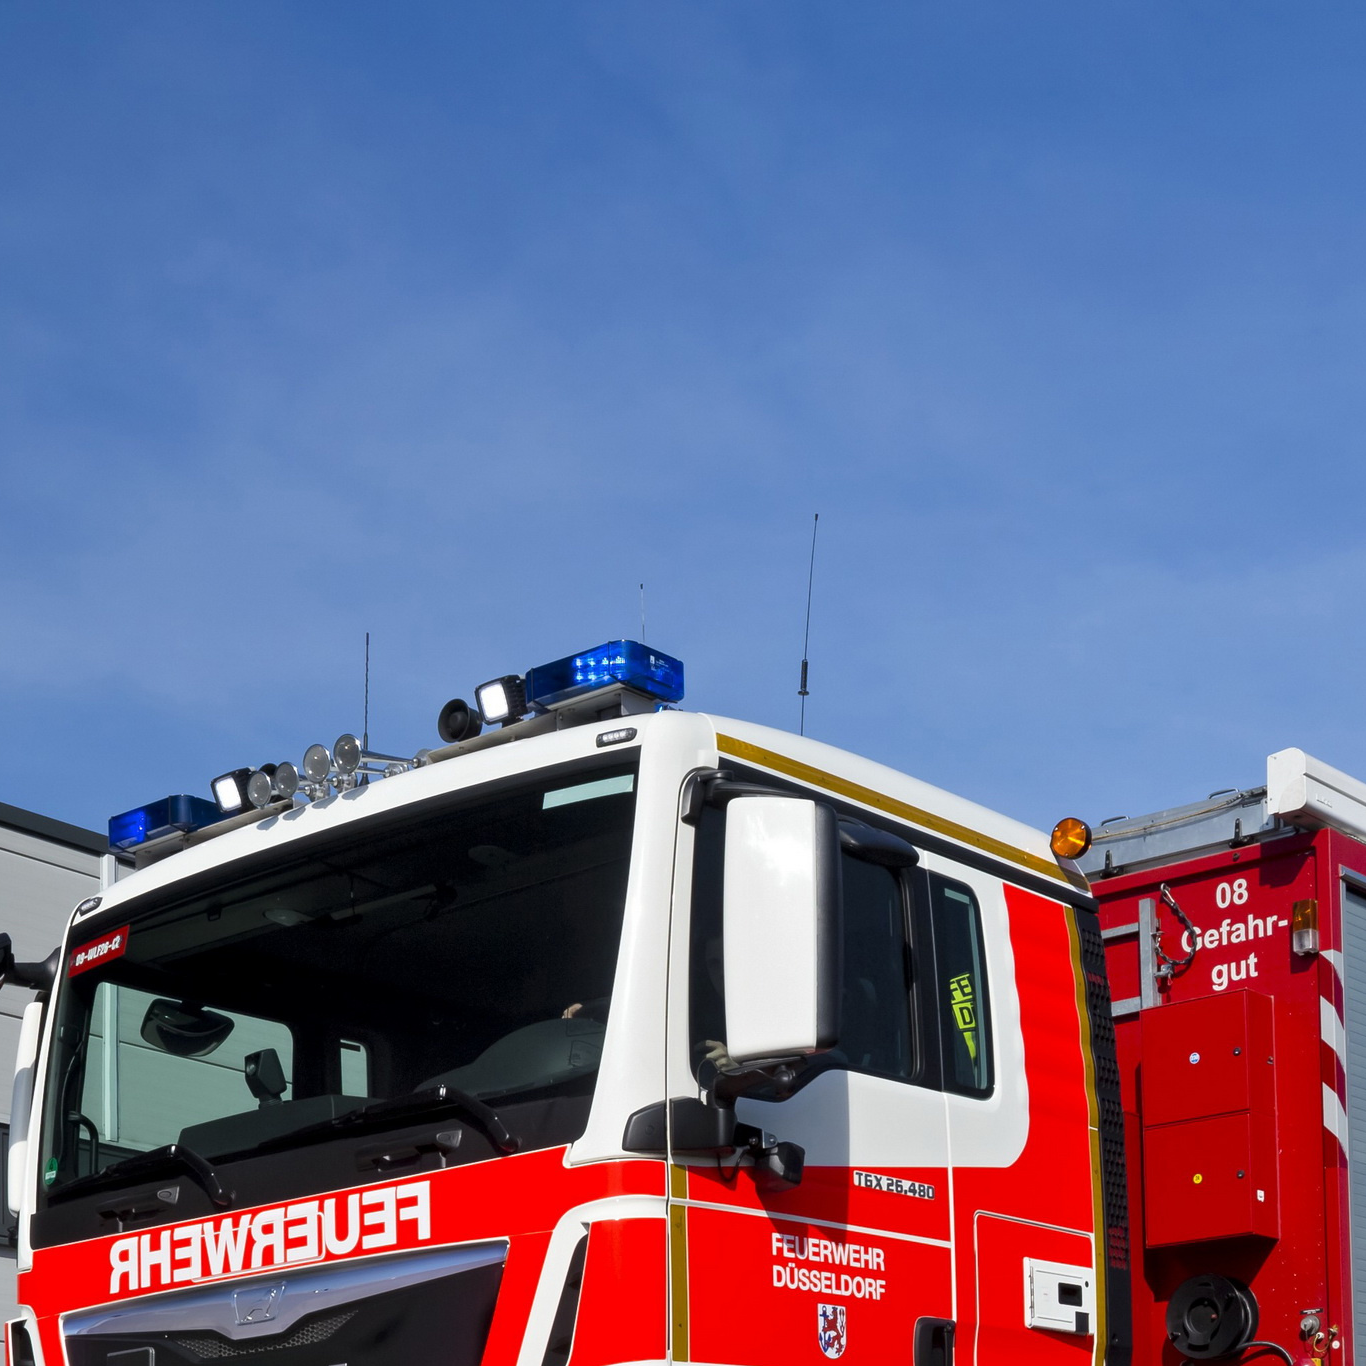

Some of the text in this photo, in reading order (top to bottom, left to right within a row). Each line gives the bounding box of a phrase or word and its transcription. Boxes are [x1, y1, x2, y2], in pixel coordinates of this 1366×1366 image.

[1216, 879, 1248, 908] 08
[1181, 914, 1288, 952] Gefahr-
[1211, 952, 1258, 991] gut
[855, 1172, 935, 1200] TGX 26.480
[771, 1232, 885, 1271] FEUERWEHR
[772, 1262, 886, 1301] DÜSSELDORF
